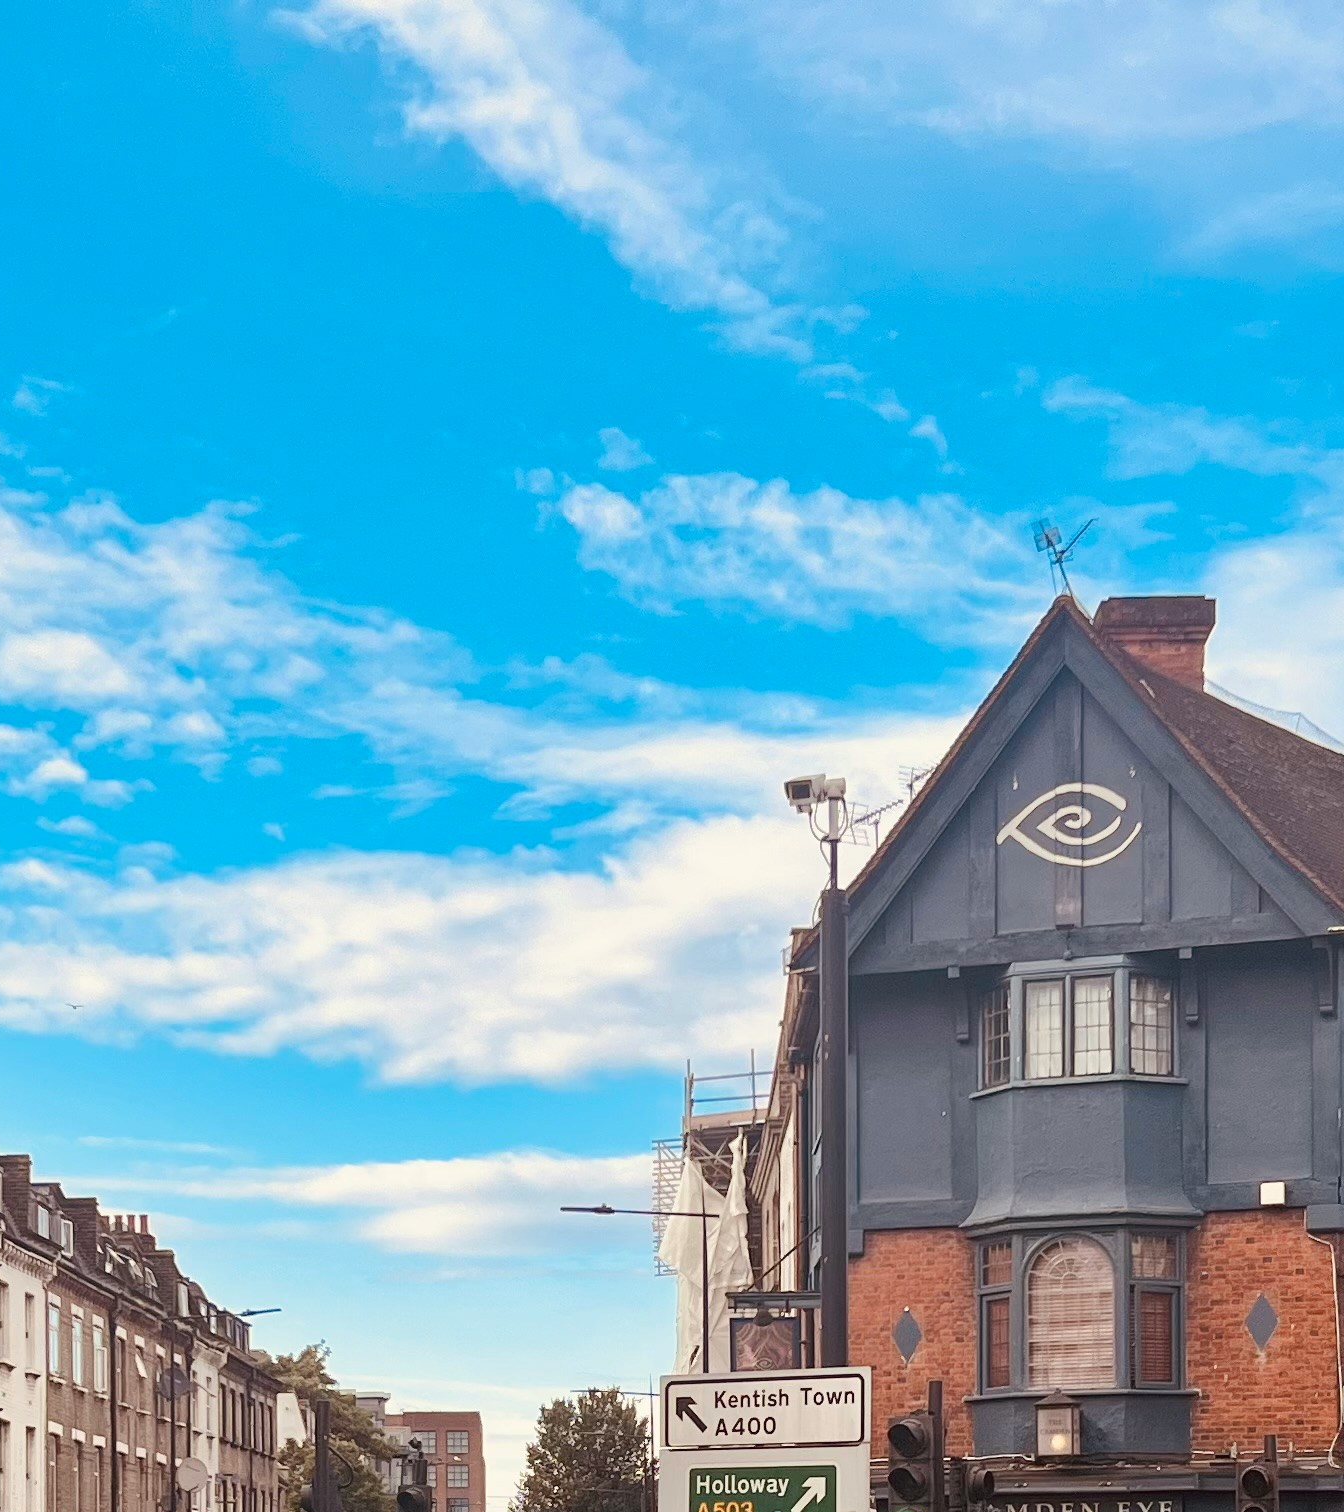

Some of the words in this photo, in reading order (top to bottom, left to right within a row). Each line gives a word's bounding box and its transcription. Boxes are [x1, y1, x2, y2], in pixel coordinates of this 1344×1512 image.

[714, 1389, 789, 1409] Kentish
[800, 1387, 855, 1405] Town
[715, 1416, 777, 1436] A400
[695, 1474, 789, 1497] Holloway
